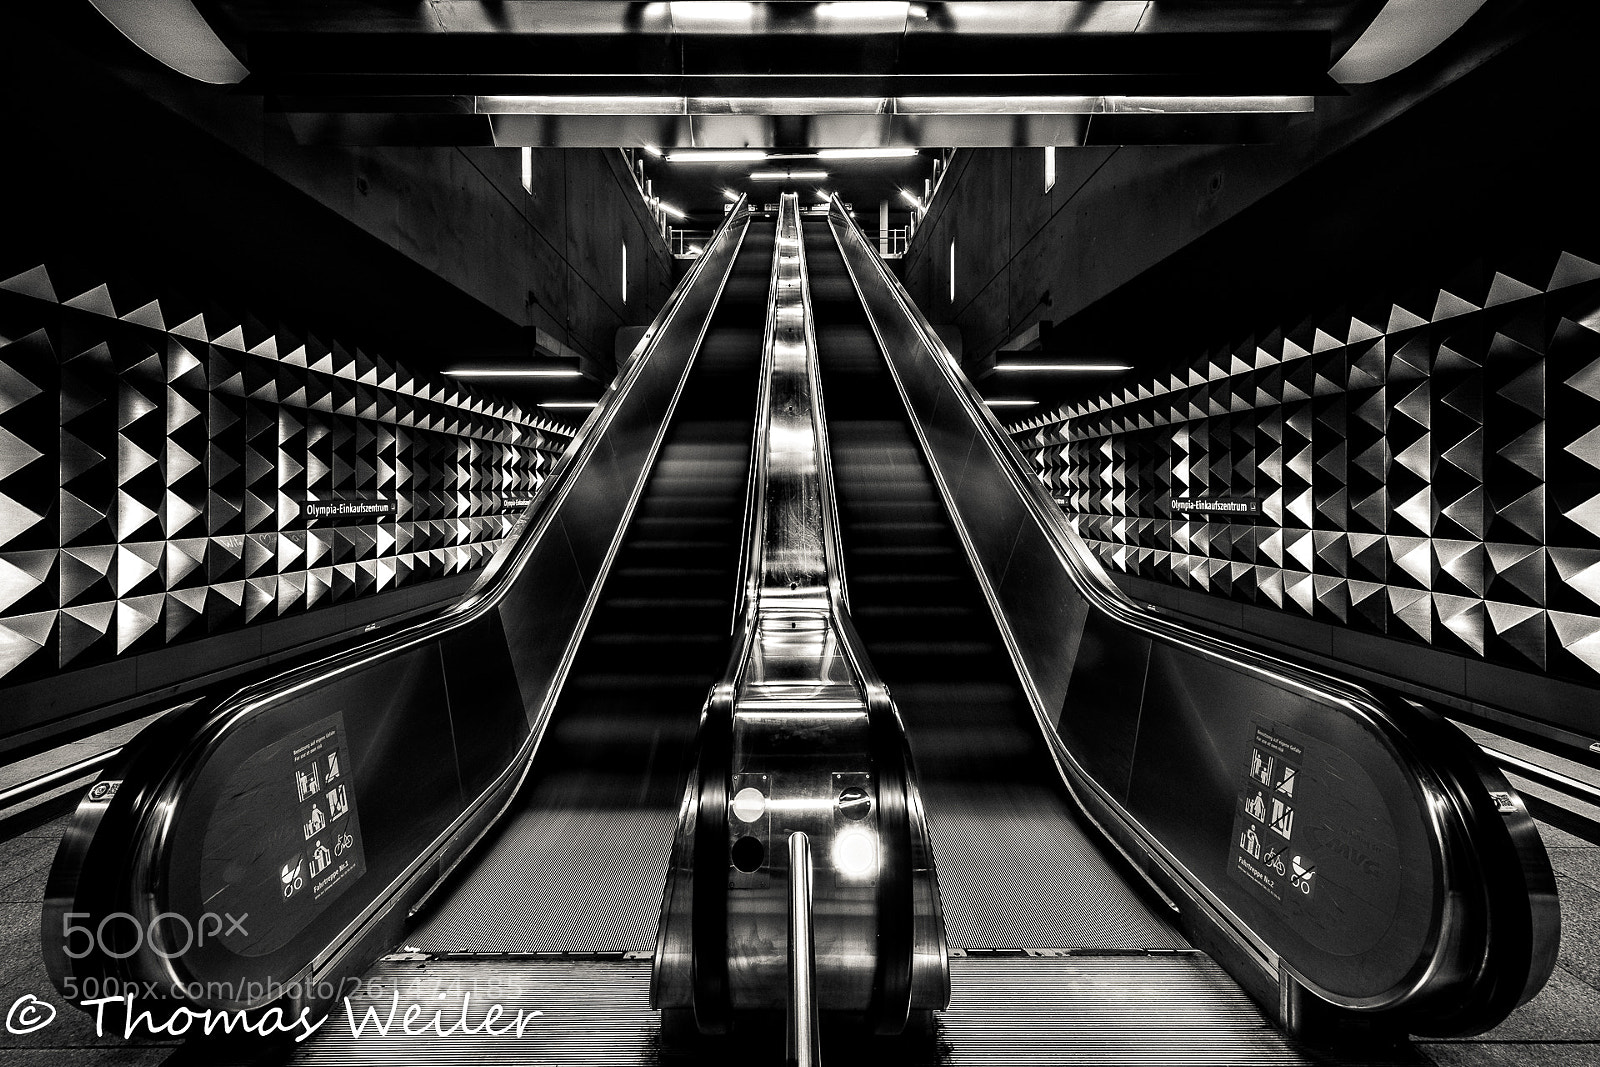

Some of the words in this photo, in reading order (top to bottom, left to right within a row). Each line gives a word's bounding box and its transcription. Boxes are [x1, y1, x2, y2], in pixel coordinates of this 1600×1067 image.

[307, 503, 389, 517] Olympia-Einkaufszentrum
[1171, 499, 1248, 512] Olympia-Einkaufszentrum
[1238, 856, 1264, 880] Fahrtreppe
[313, 869, 339, 894] Fahrtreppe
